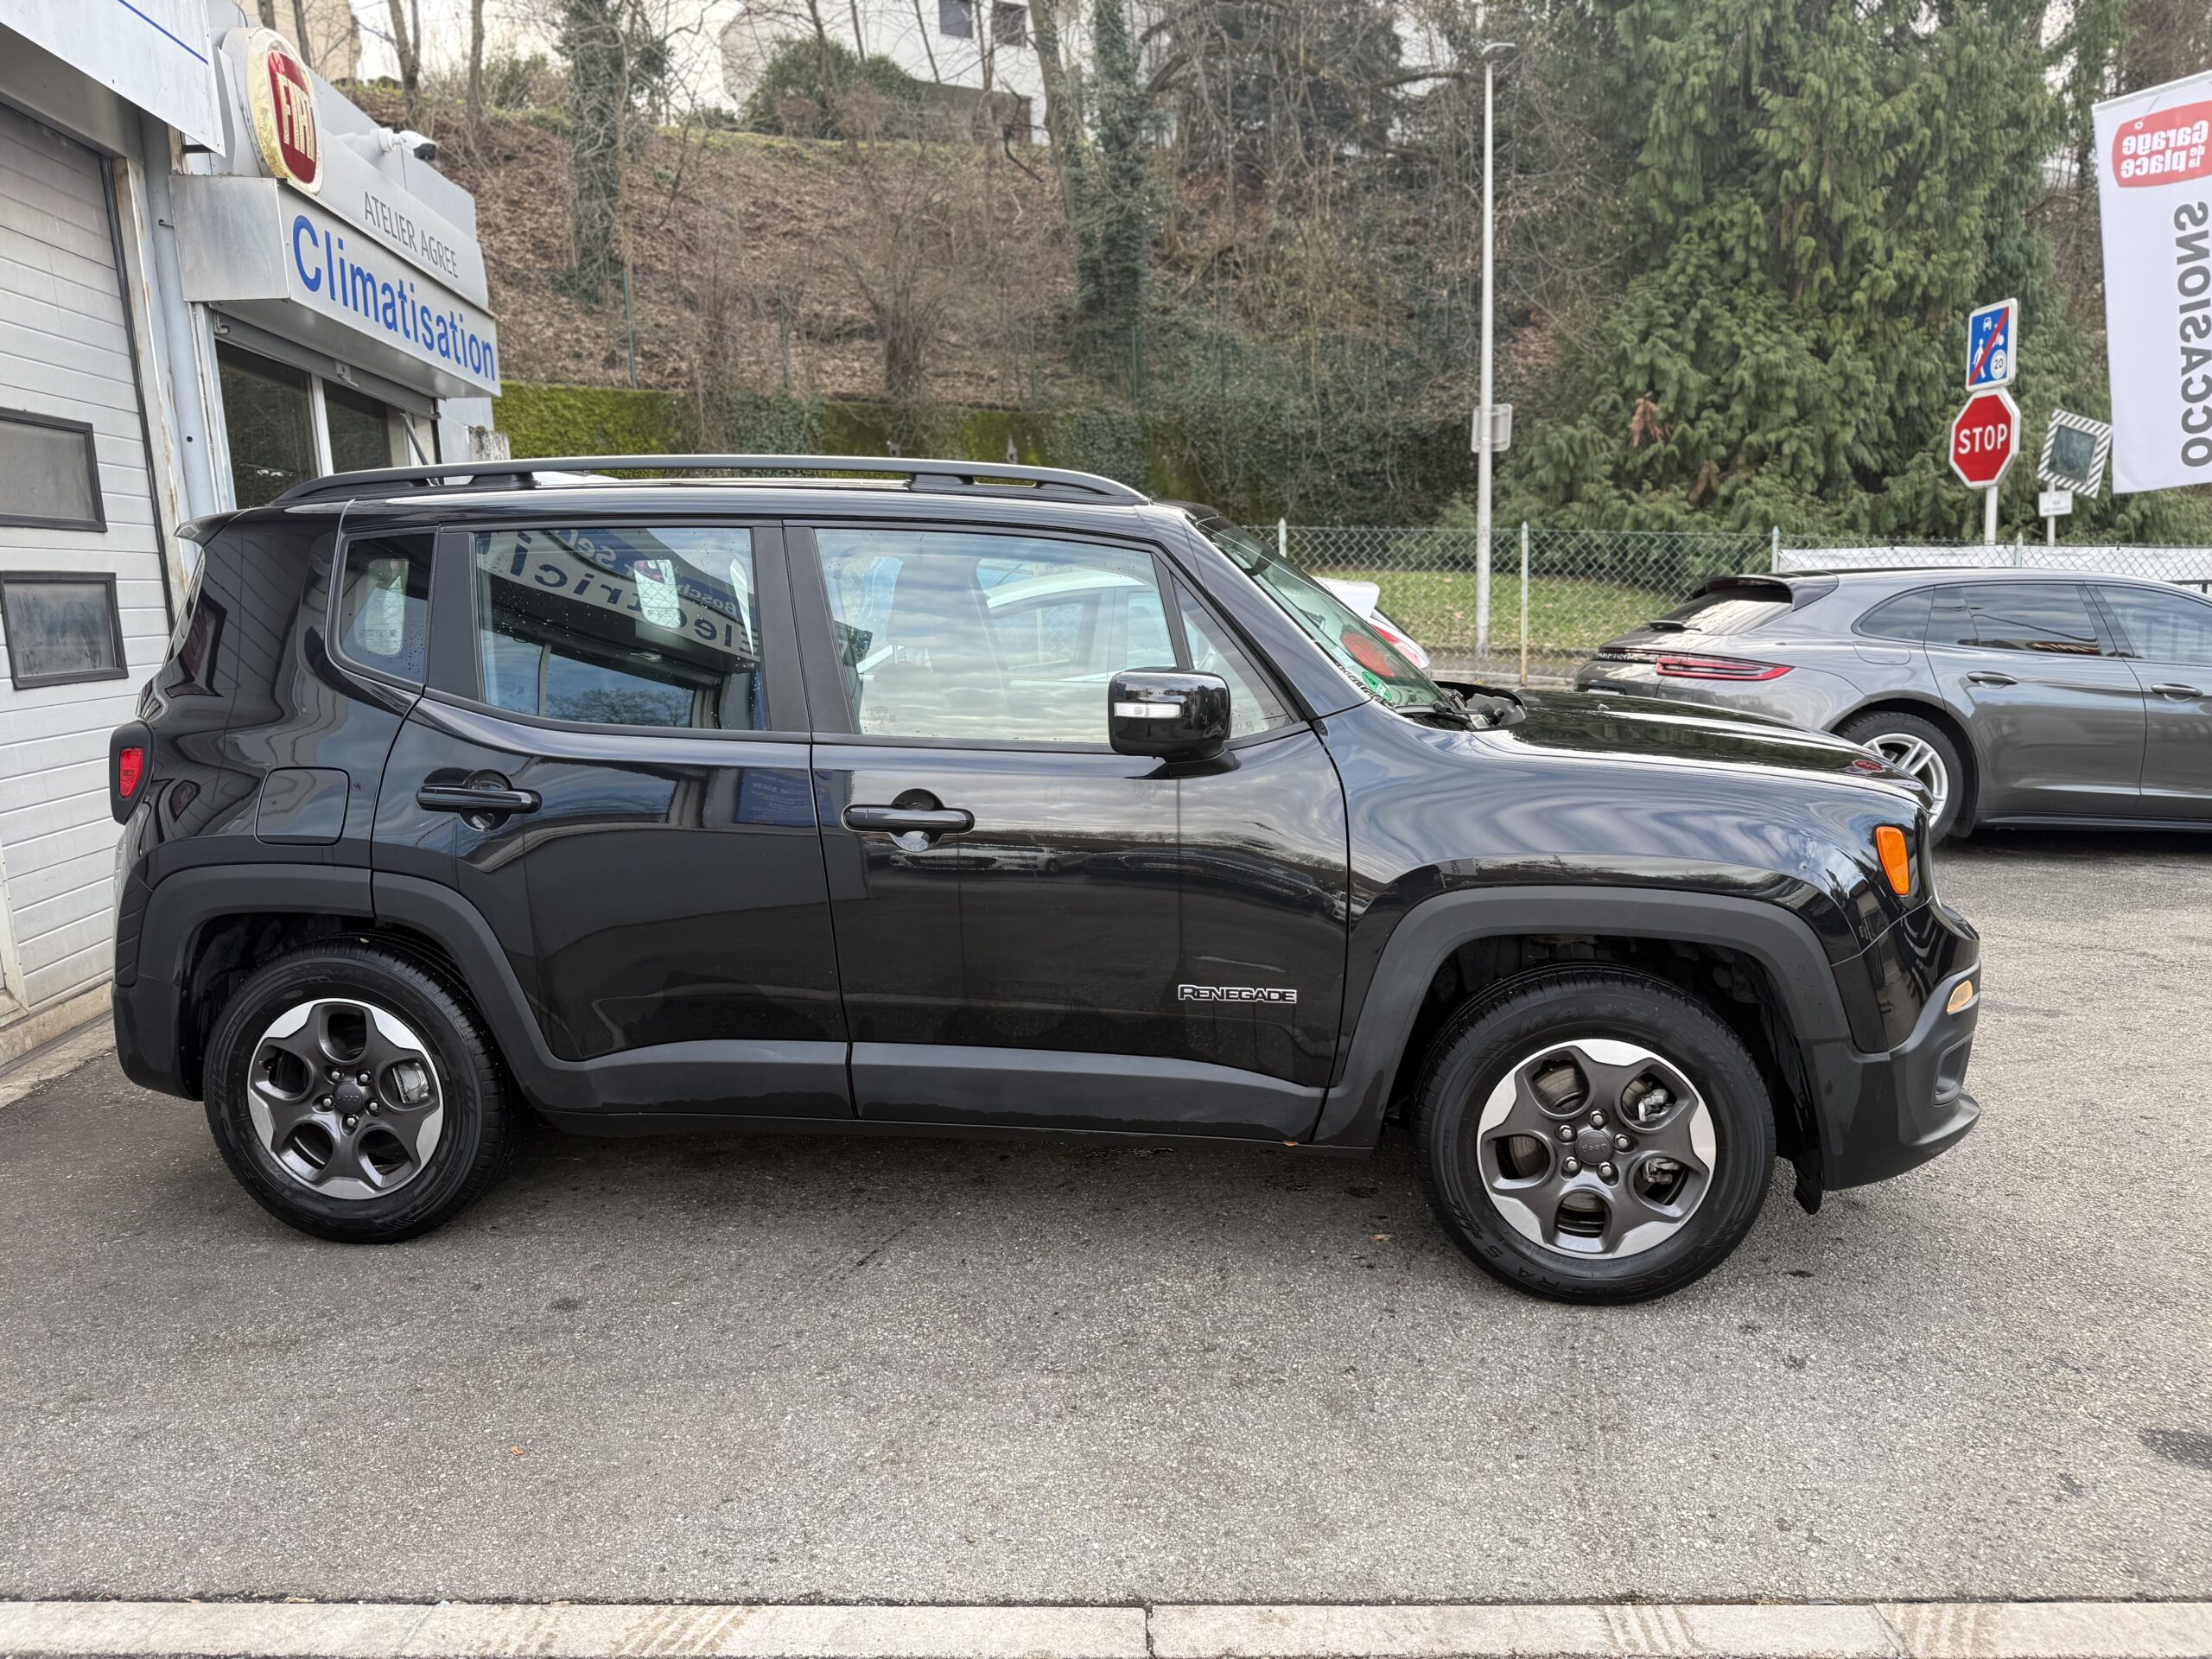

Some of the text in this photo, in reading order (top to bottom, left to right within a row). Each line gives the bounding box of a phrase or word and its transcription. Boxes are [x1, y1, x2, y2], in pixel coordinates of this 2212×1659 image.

[276, 72, 315, 162] FIAT
[365, 191, 459, 279] ATELIER AGREE
[292, 214, 496, 382] Climatisation
[1994, 358, 2004, 370] 20
[1957, 423, 2008, 454] STOP
[1178, 984, 1297, 1004] RENEGADE
